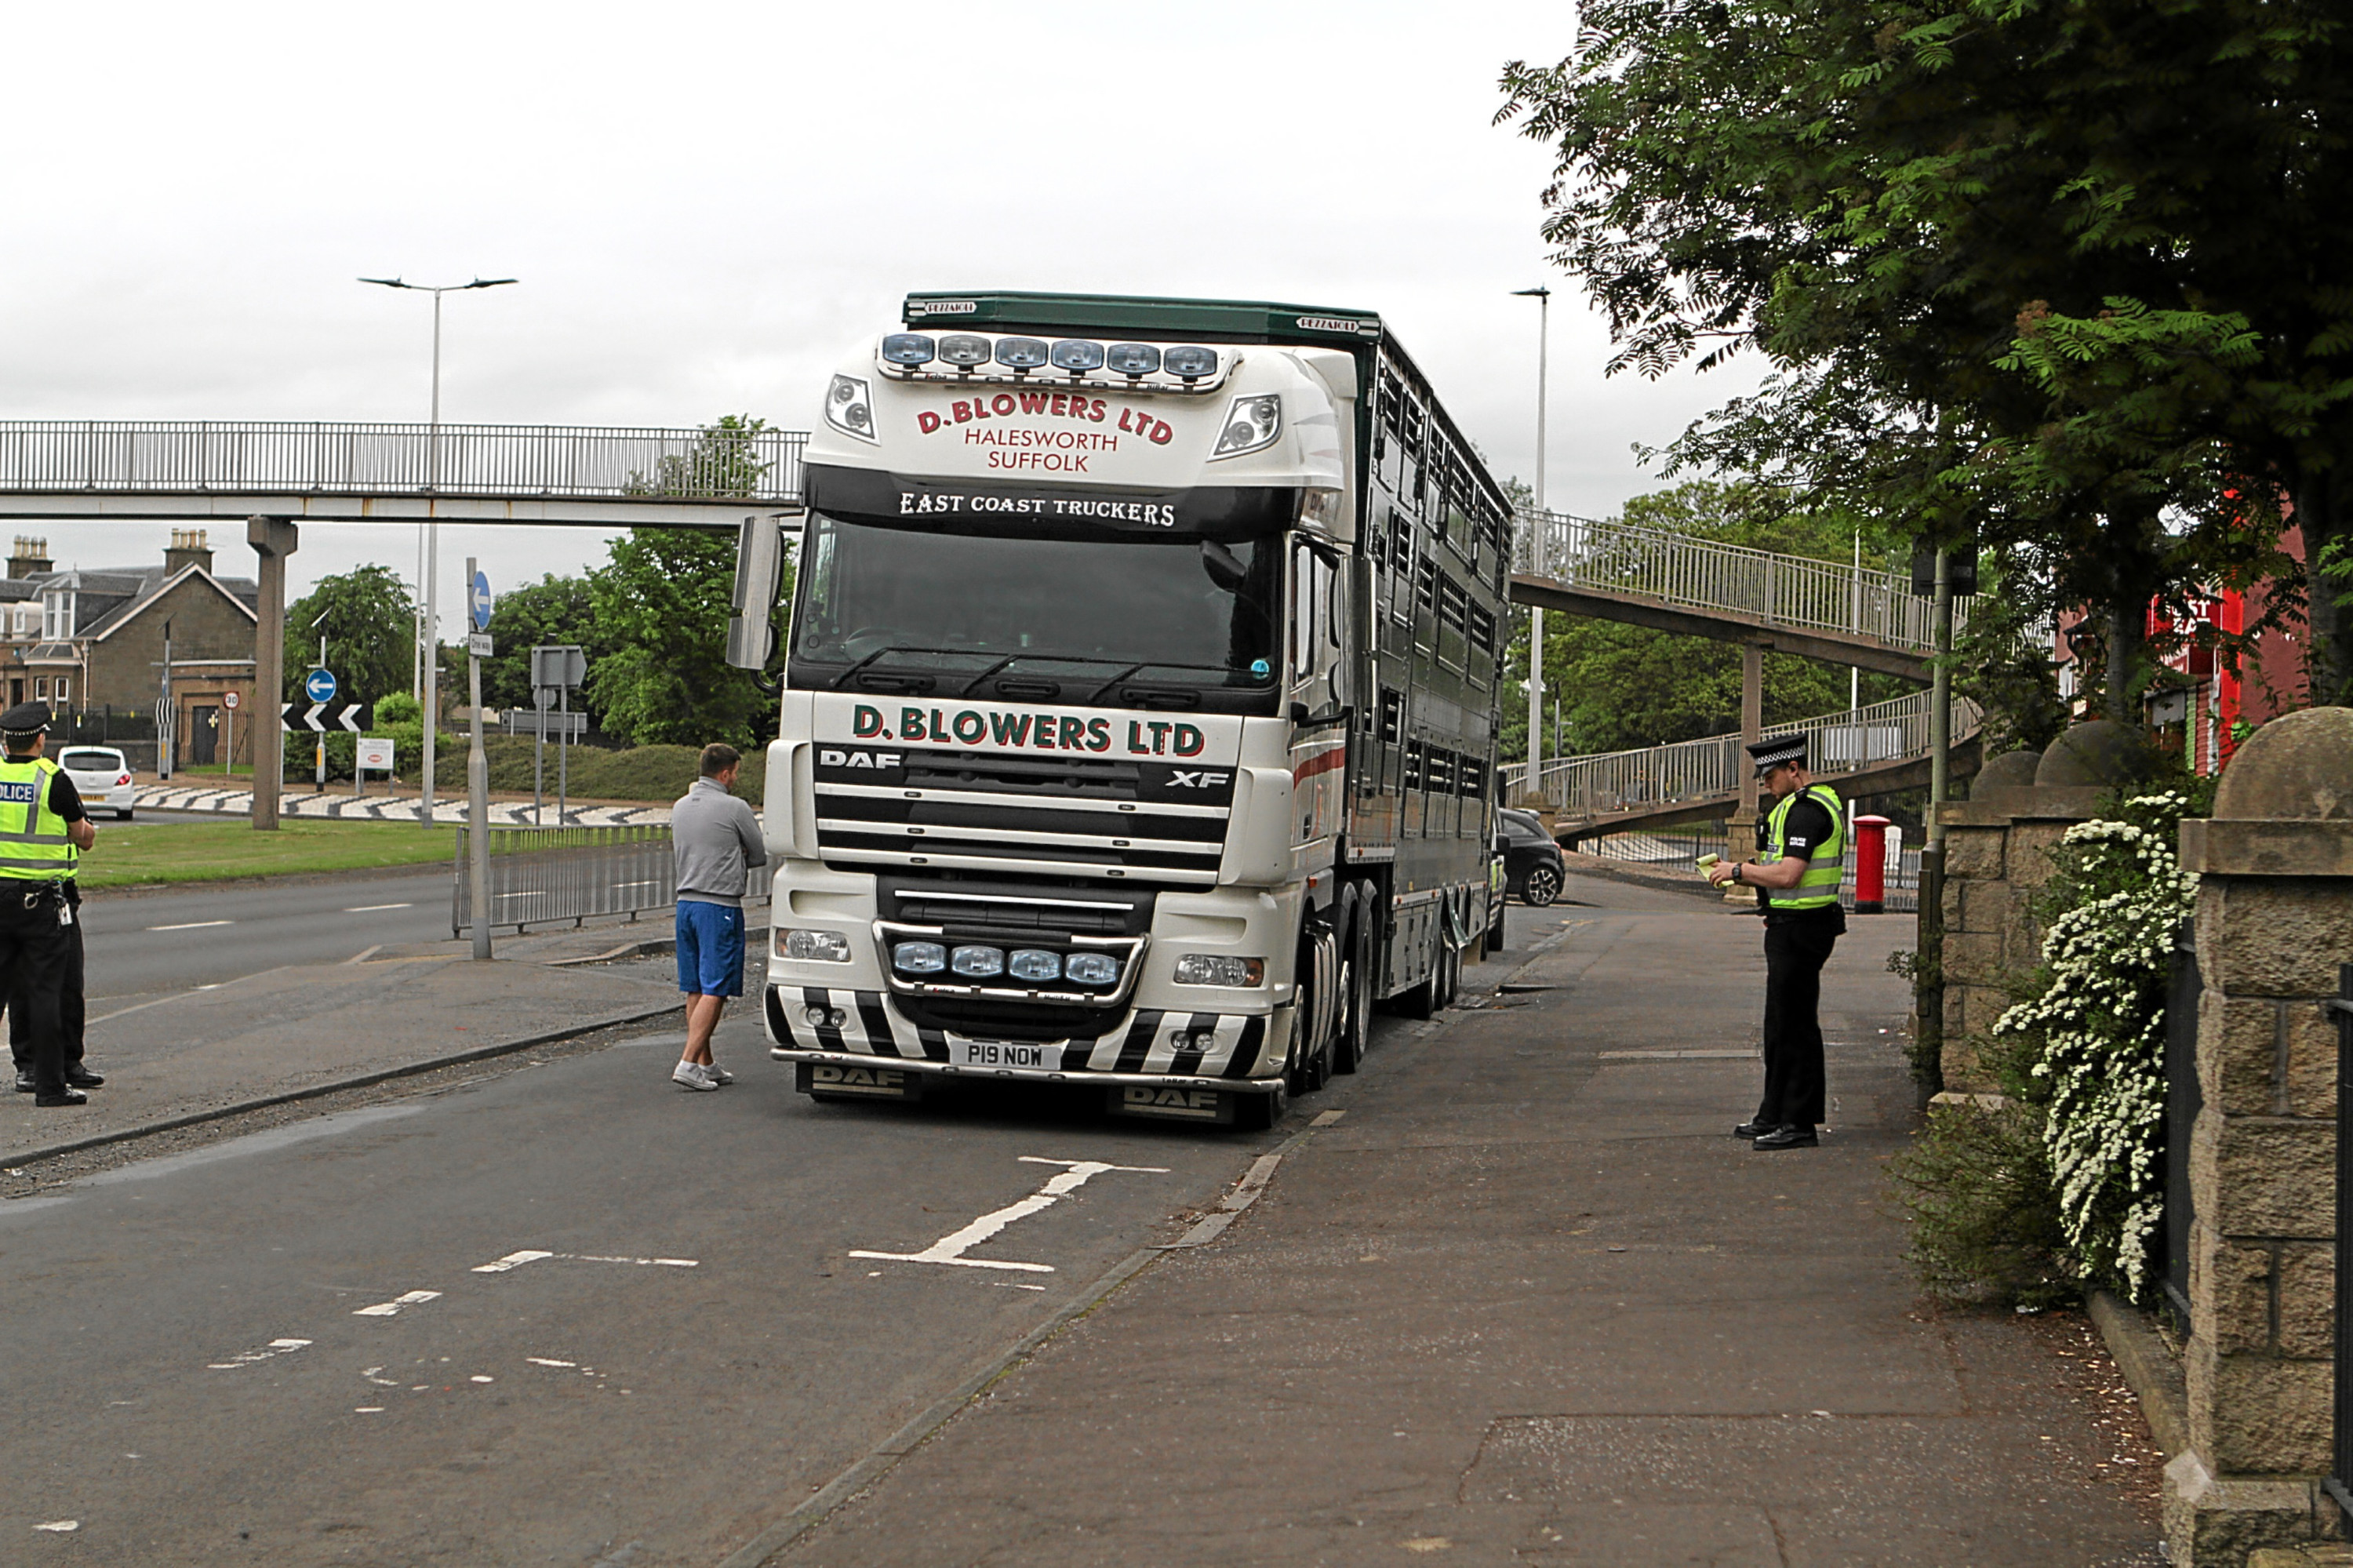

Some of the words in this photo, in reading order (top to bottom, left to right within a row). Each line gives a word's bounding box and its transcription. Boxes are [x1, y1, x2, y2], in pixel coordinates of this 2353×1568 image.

[928, 303, 973, 313] PEZZAIOLI
[1301, 318, 1355, 331] PEZZAIOLI
[917, 392, 1107, 435] D.BLOWERS
[1118, 407, 1173, 446] LTD
[964, 428, 1118, 452] HALESWORTH
[987, 451, 1089, 472] SUFFOLK
[900, 493, 965, 515] EAST
[970, 496, 1046, 514] COAST
[1053, 500, 1176, 527] TRUCKERS
[471, 638, 481, 649] One
[482, 642, 490, 652] way
[227, 695, 238, 704] 30
[853, 704, 1111, 753] D.BLOWERS
[1127, 719, 1205, 758] LTD
[820, 750, 901, 769] DAF
[1164, 770, 1230, 788] XF
[967, 1045, 998, 1064] P19
[1004, 1046, 1042, 1066] NOW
[813, 1066, 904, 1086] DAF
[1124, 1086, 1217, 1108] DAF
